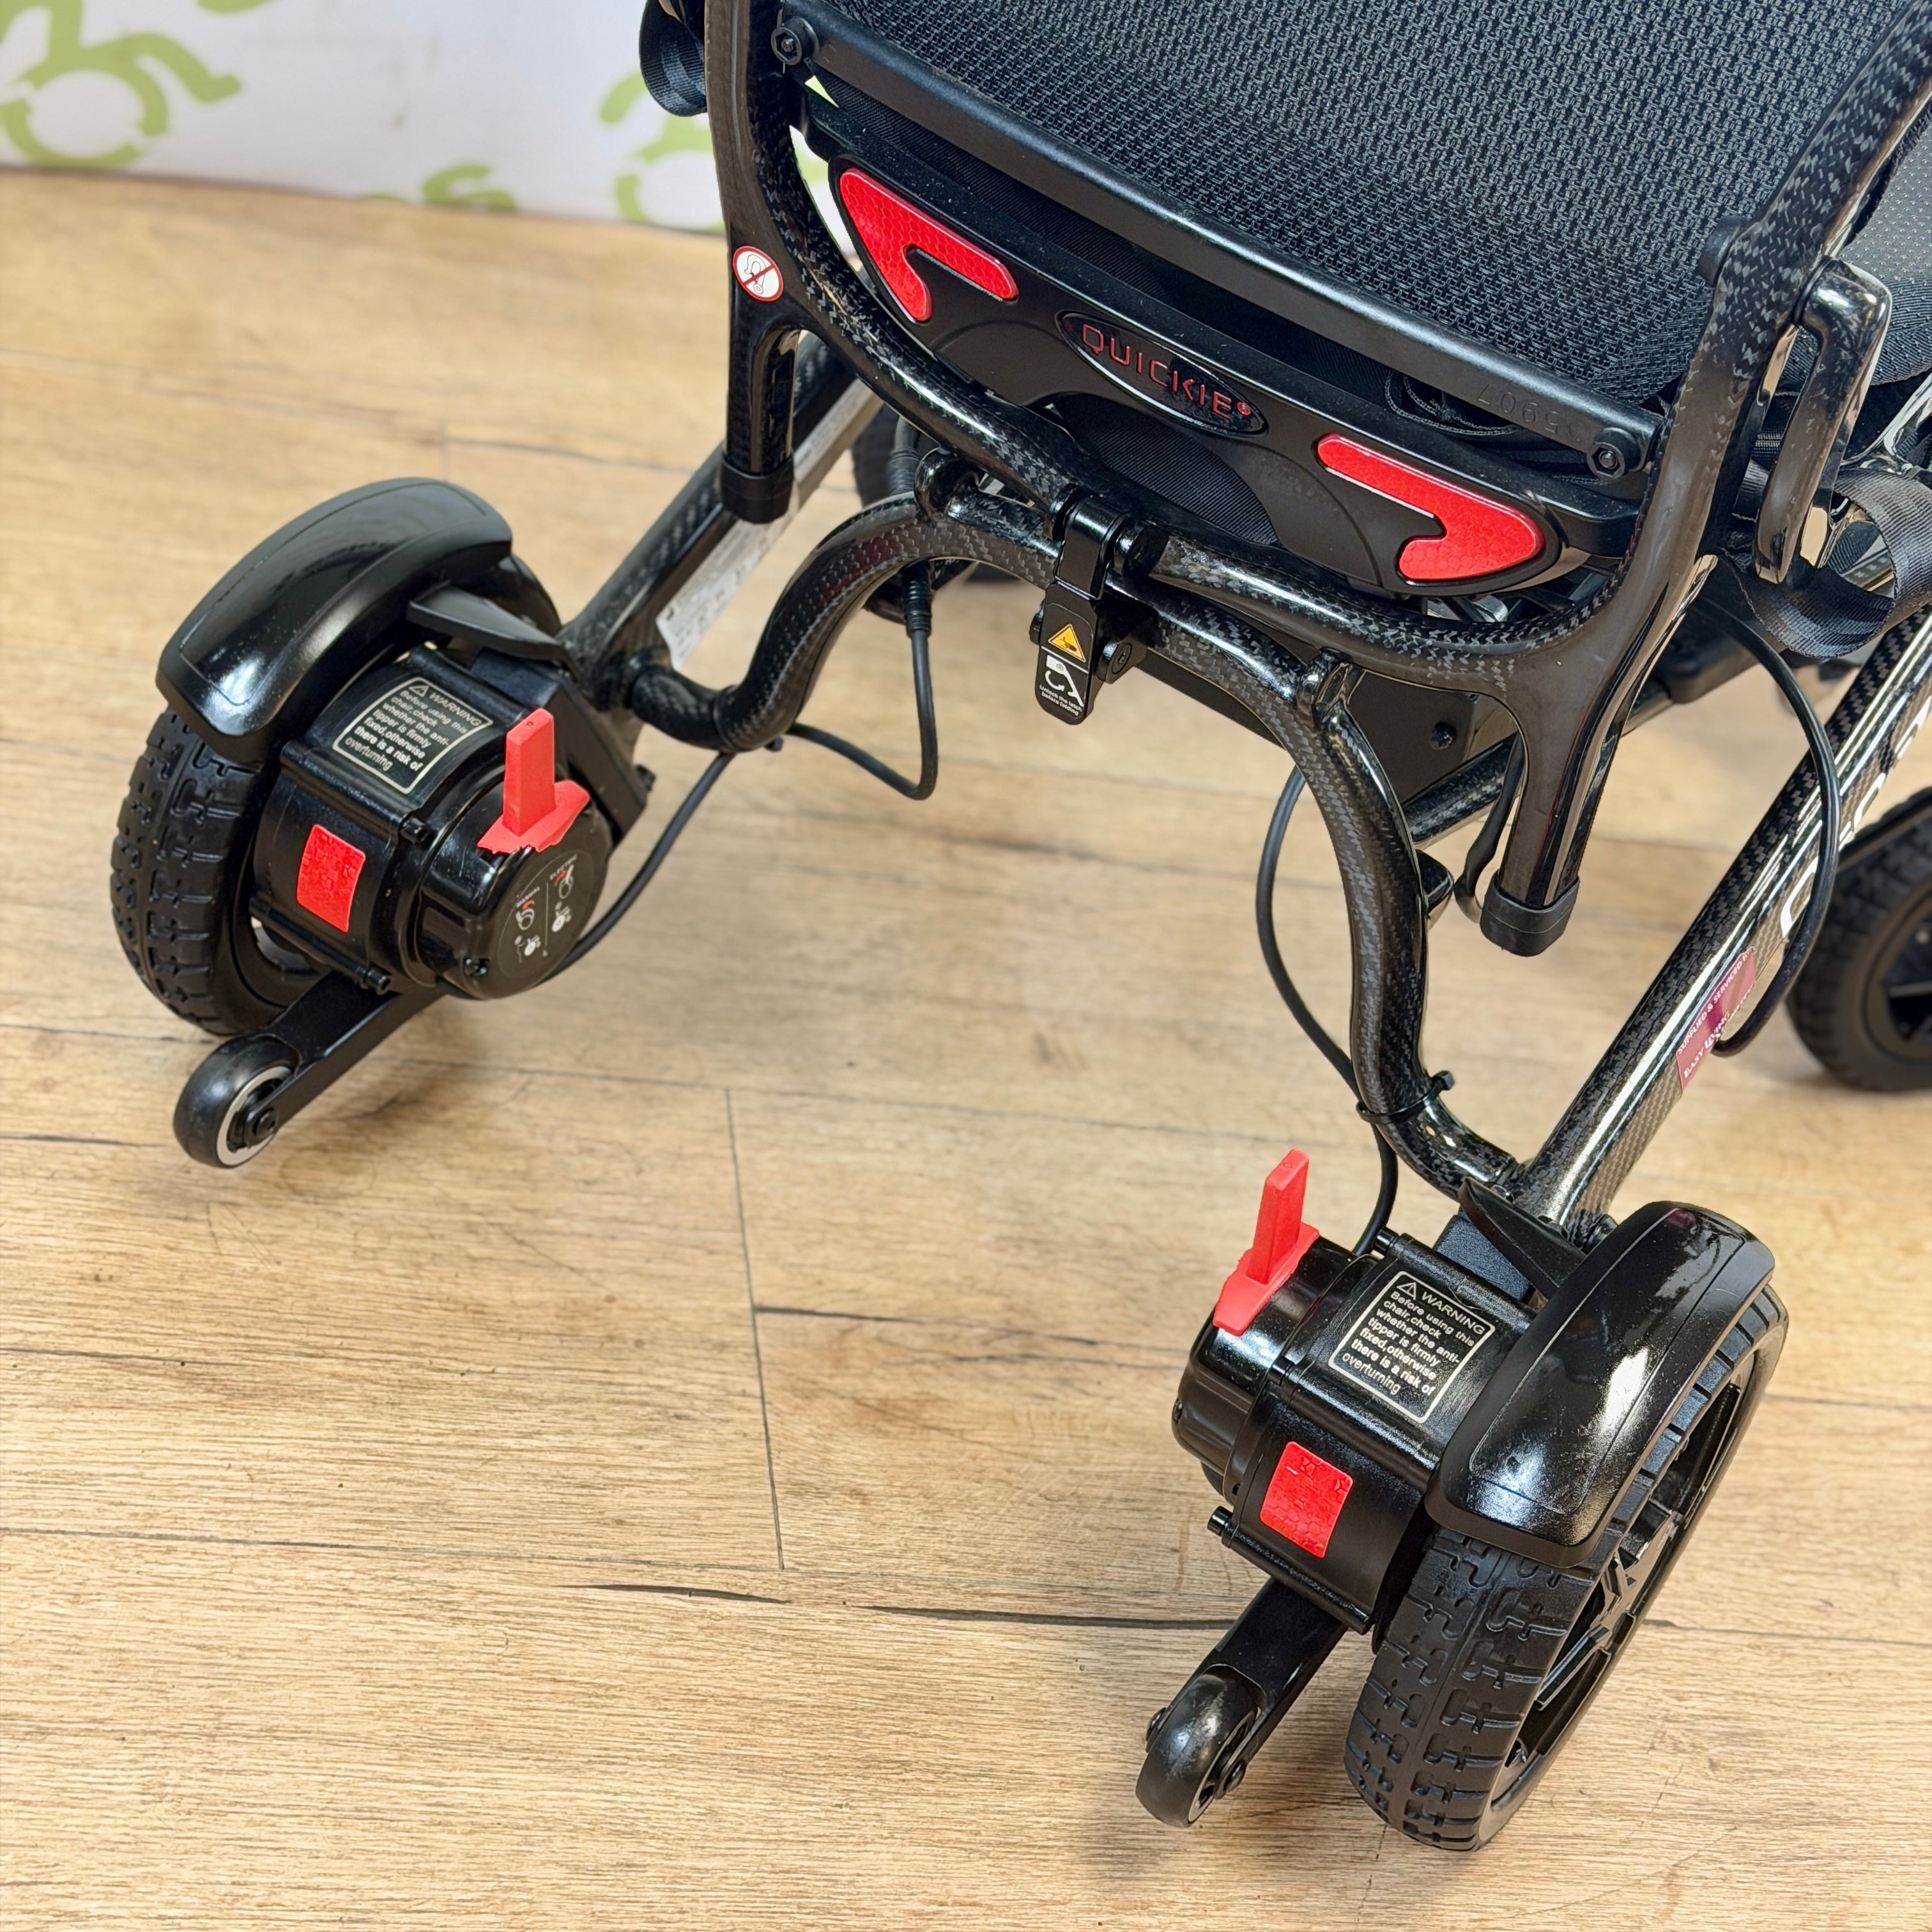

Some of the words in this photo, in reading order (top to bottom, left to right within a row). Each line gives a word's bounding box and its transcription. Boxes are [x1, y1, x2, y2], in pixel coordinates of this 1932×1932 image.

[400, 690, 428, 709] Before
[429, 708, 451, 724] using
[451, 721, 468, 733] this
[430, 693, 482, 726] WARNING
[1039, 684, 1058, 698] Unlock
[1059, 694, 1068, 704] the
[1069, 700, 1082, 712] latch
[1041, 691, 1059, 705] before
[1059, 702, 1079, 716] folding
[373, 709, 399, 728] tipper
[398, 724, 406, 733] is
[406, 730, 431, 749] firmly
[382, 703, 416, 725] whether
[415, 722, 431, 734] the
[430, 732, 450, 746] anti-
[345, 737, 392, 771] overturning
[354, 726, 379, 745] there
[377, 739, 387, 749] is
[394, 750, 411, 765] risk
[410, 760, 423, 772] of
[1676, 1011, 1706, 1054] SUPPLIED
[1707, 1002, 1713, 1012] &
[1713, 962, 1742, 1003] SERVICED
[1684, 1048, 1705, 1079] EASY
[1390, 1291, 1425, 1315] Before
[1426, 1314, 1454, 1335] using
[1455, 1331, 1475, 1347] this
[1422, 1291, 1486, 1335] WARNING
[1368, 1317, 1399, 1340] tipper
[1400, 1335, 1410, 1347] is
[1411, 1342, 1441, 1367] firmly
[1377, 1309, 1418, 1337] whether
[1418, 1334, 1435, 1349] the
[1436, 1346, 1460, 1364] anti-
[1342, 1352, 1401, 1395] overturning
[1351, 1339, 1379, 1361] there
[1380, 1354, 1390, 1368] is
[1391, 1363, 1400, 1374] a
[1400, 1368, 1421, 1389] risk
[1422, 1381, 1436, 1395] of
